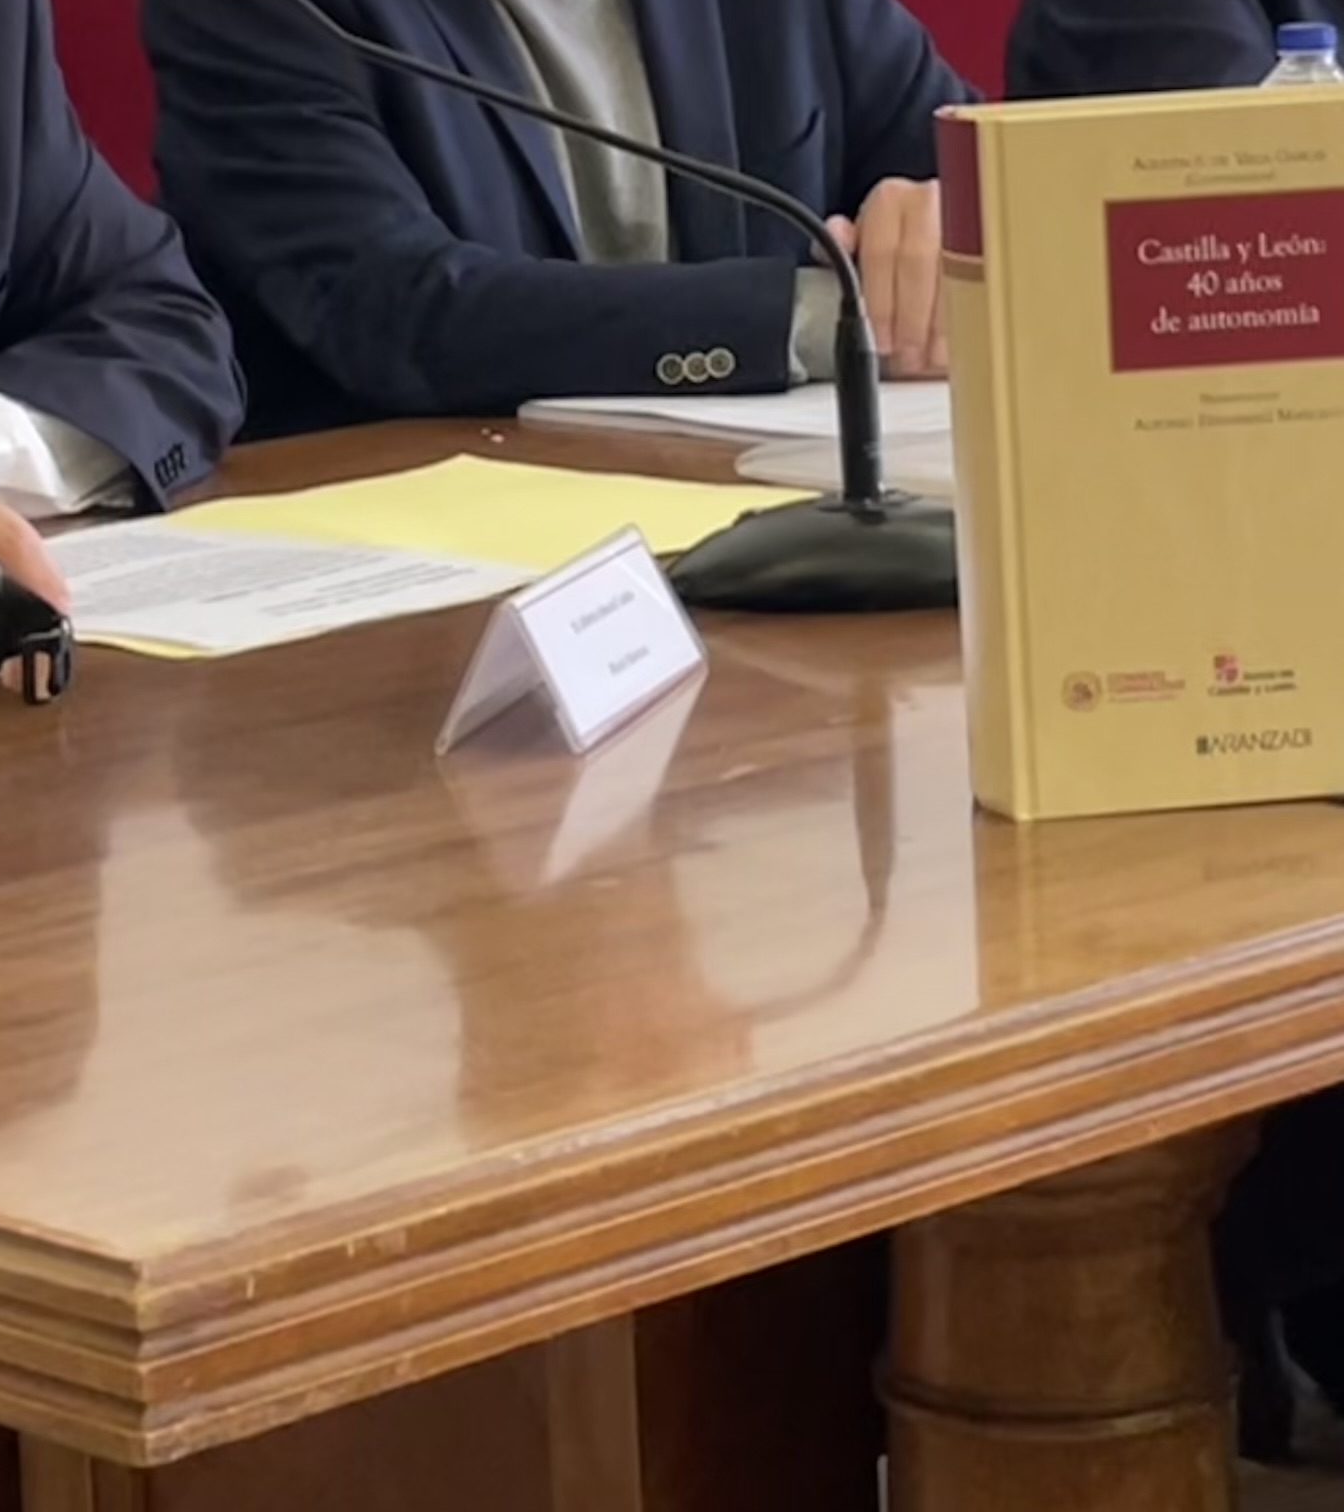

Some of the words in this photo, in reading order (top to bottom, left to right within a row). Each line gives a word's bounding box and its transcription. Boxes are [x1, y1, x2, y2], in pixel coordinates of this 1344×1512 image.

[1137, 235, 1231, 265] Castilla
[1236, 241, 1252, 264] y
[1258, 232, 1327, 258] León:
[1186, 270, 1220, 298] 40
[1224, 271, 1283, 295] años
[1150, 306, 1181, 334] de
[1188, 303, 1320, 332] autonomía
